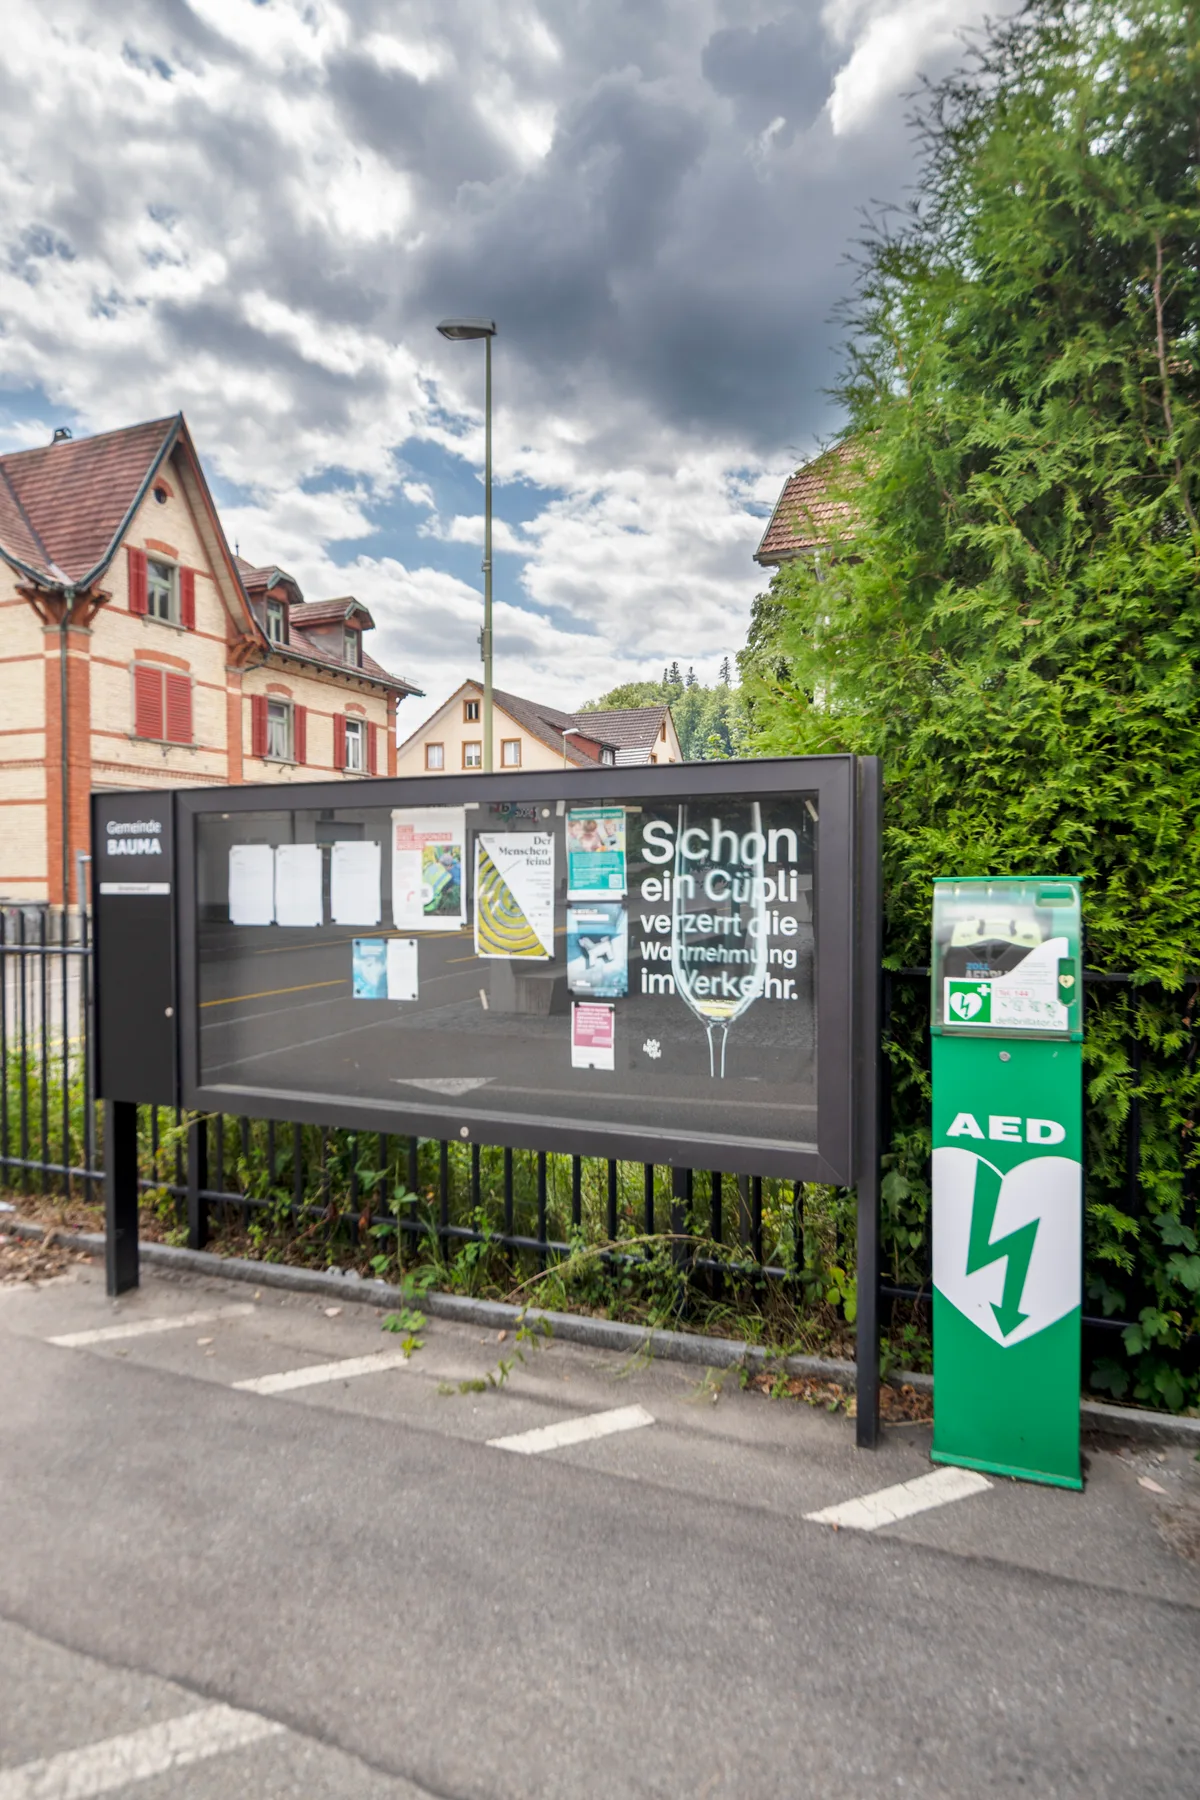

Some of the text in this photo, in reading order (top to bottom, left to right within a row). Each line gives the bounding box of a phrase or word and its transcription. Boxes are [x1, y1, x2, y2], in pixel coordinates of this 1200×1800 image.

[106, 820, 162, 835] Gemeinde
[533, 836, 551, 845] Der
[107, 838, 162, 855] BAUMA
[641, 818, 798, 866] Schon
[526, 857, 551, 866] feind
[640, 870, 695, 902] ein
[704, 868, 798, 909] Cüpli
[640, 910, 798, 938] verzerrt die
[640, 939, 798, 969] Wahrnehmung
[641, 968, 798, 1000] im Verkehr.
[995, 1016, 1064, 1028] defibrillator.ch
[945, 1112, 1066, 1145] AED
